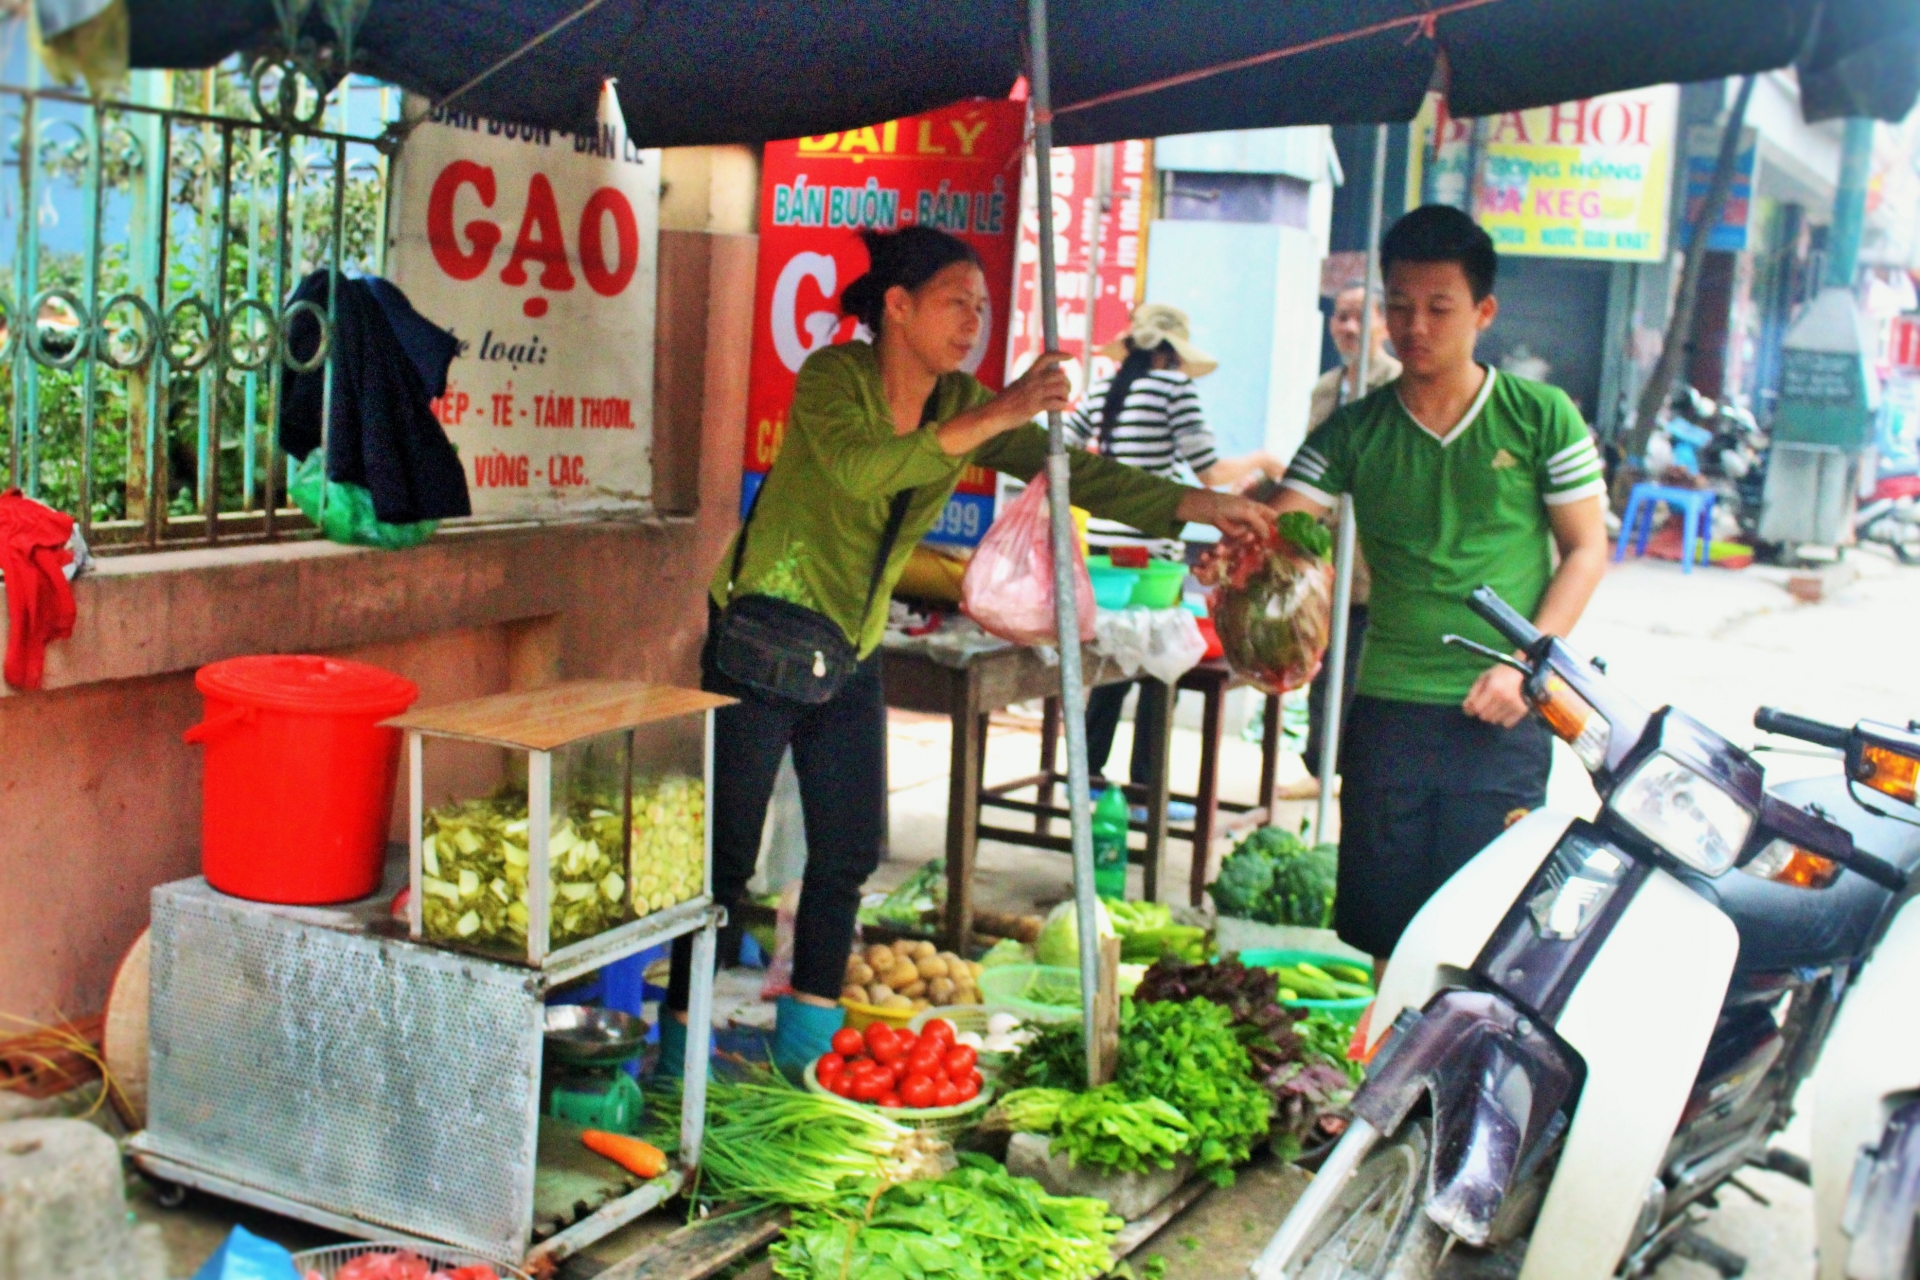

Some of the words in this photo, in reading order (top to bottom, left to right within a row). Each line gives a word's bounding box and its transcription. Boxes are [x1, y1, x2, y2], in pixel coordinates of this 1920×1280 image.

[917, 110, 988, 155] LÝ
[774, 174, 825, 227] BÁN
[828, 176, 898, 228] BUÔN
[918, 178, 971, 233] BÁN
[1535, 189, 1601, 219] KEG
[427, 160, 639, 318] GẠO
[479, 330, 548, 371] loại:
[492, 379, 513, 427] TẺ
[534, 389, 575, 428] TÁM
